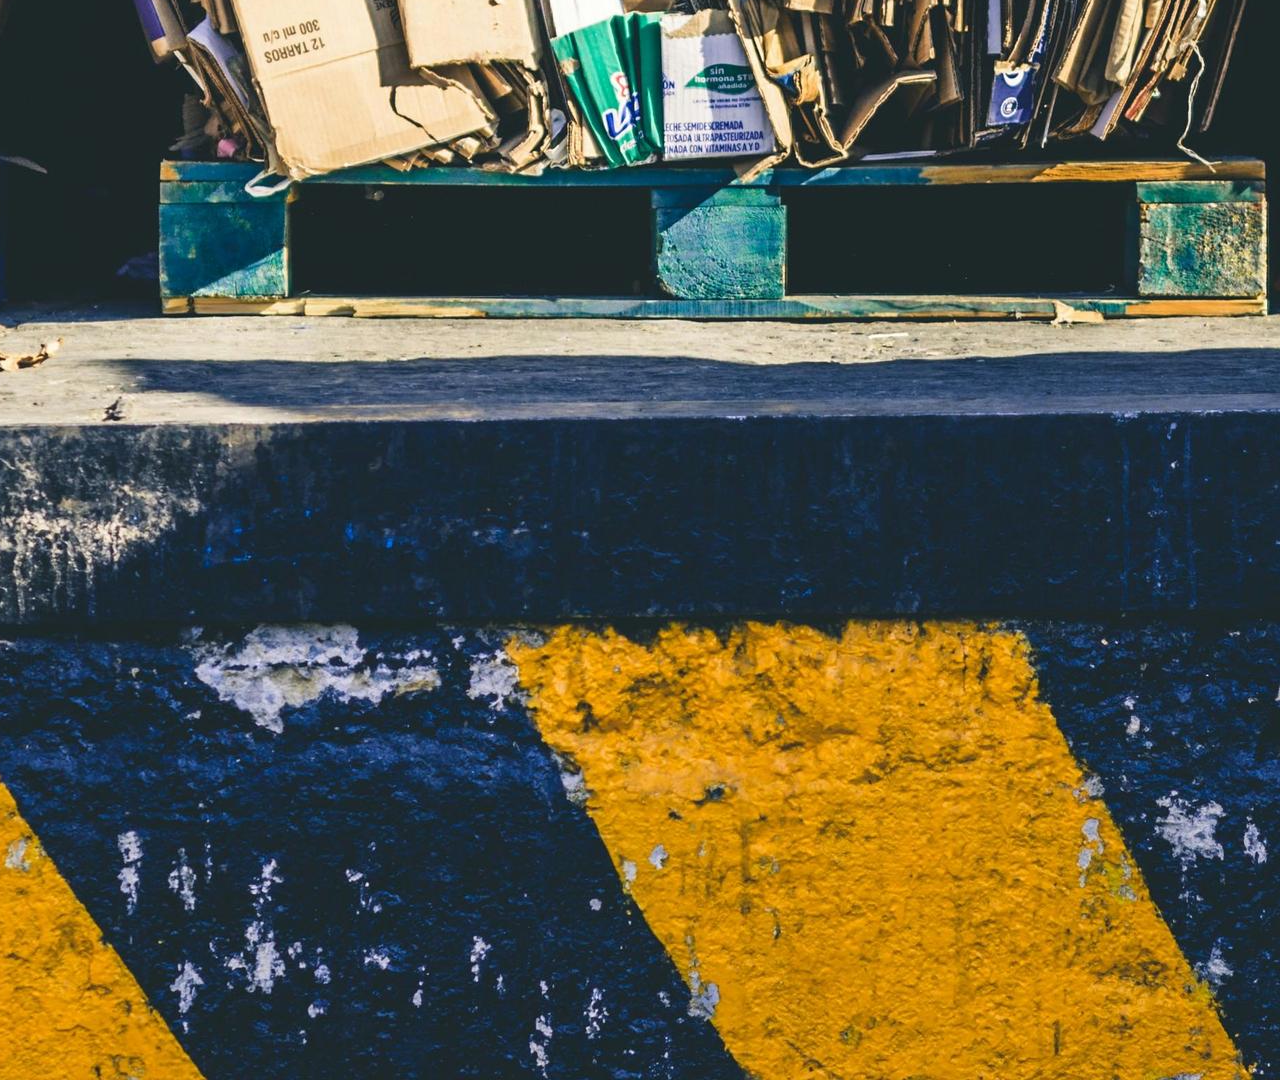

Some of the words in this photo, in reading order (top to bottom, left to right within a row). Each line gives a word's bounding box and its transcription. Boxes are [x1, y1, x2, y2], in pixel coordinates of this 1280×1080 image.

[282, 26, 297, 40] ml
[299, 19, 321, 36] 300
[263, 30, 281, 44] c/u
[311, 37, 326, 51] 12
[264, 42, 310, 63] TARROS
[710, 66, 724, 75] sin
[695, 75, 735, 83] hormona
[717, 81, 748, 89] añadida
[683, 120, 744, 131] SEMIDESCREMADA
[693, 130, 764, 142] ULTRAPASTEURIZADA
[689, 143, 704, 153] CON
[704, 142, 742, 153] VITAMINAS
[741, 141, 748, 152] A
[754, 141, 760, 151] D
